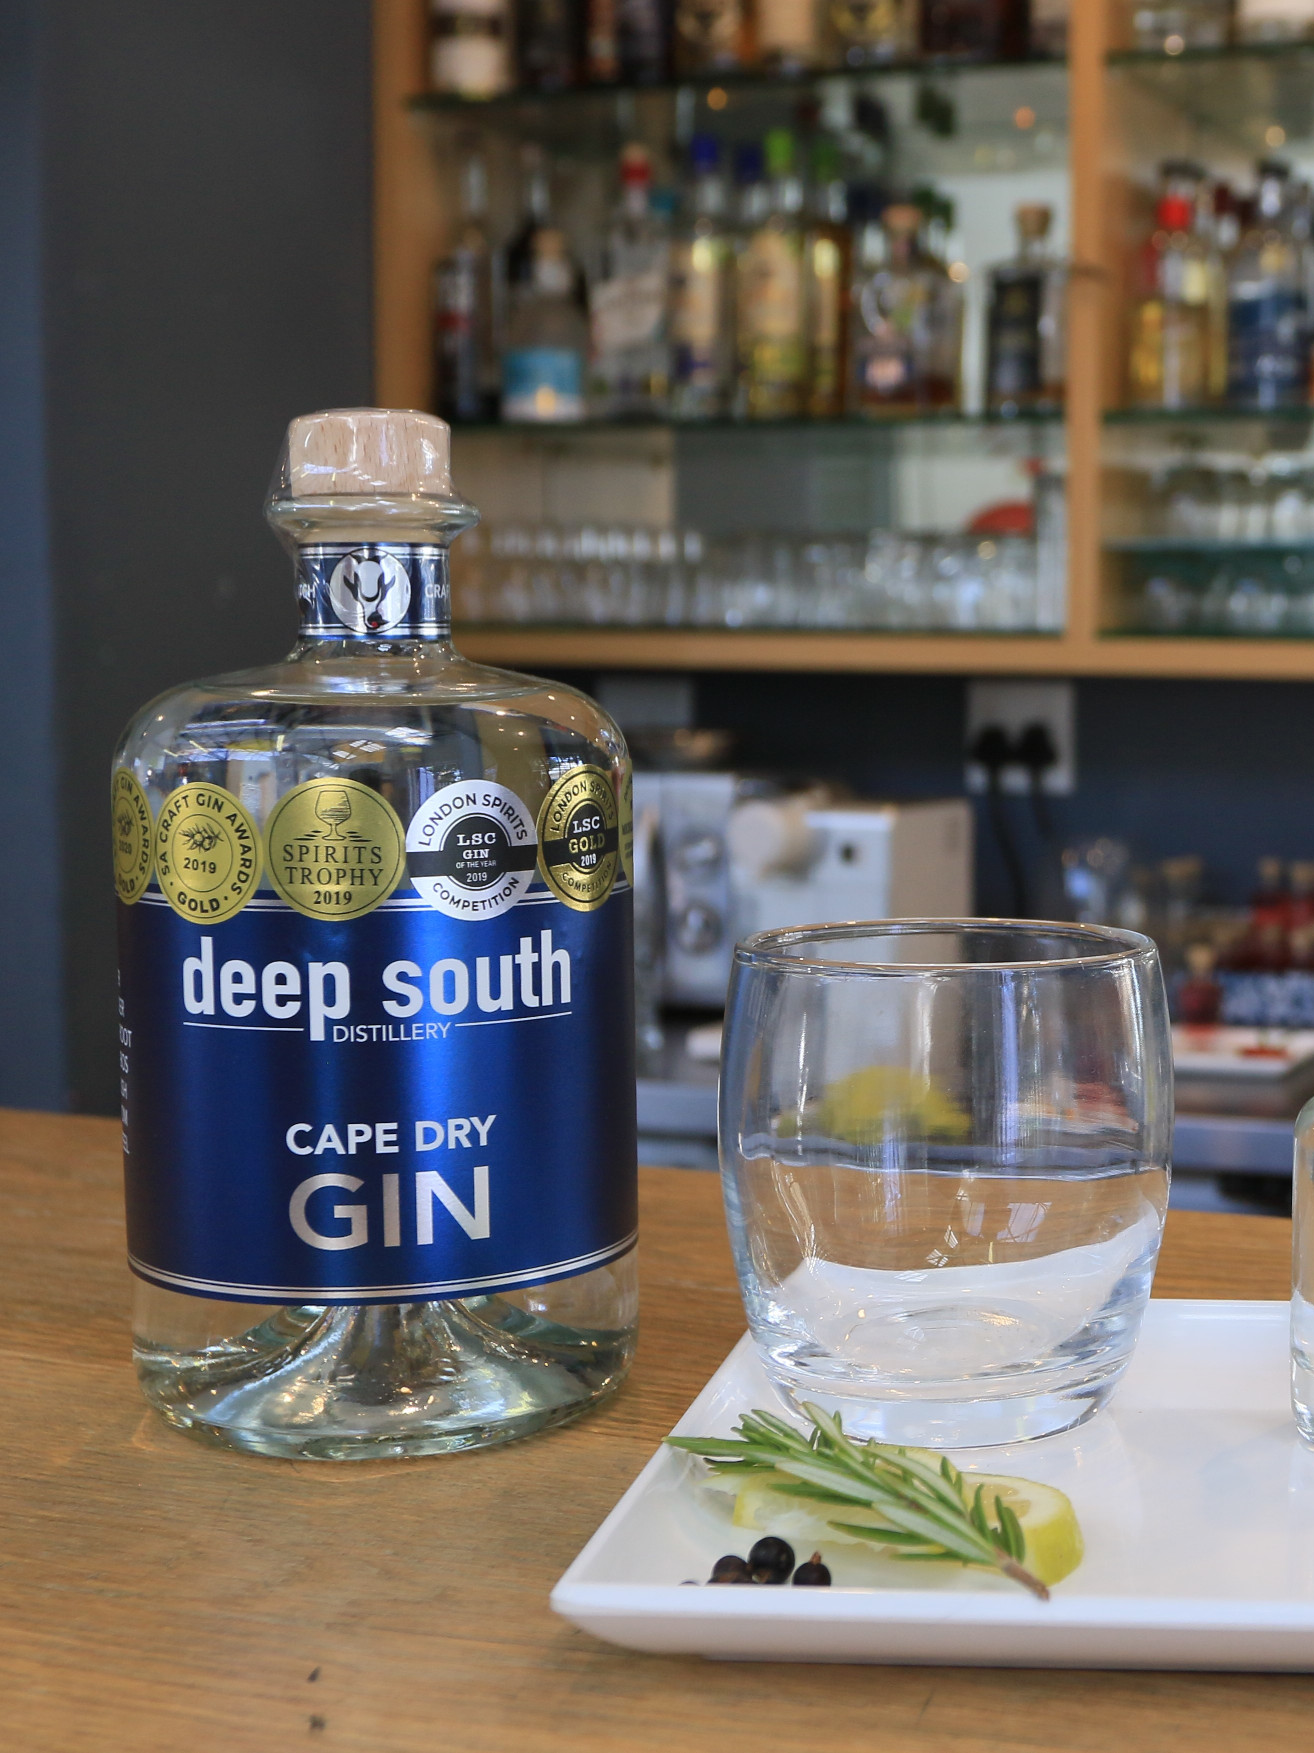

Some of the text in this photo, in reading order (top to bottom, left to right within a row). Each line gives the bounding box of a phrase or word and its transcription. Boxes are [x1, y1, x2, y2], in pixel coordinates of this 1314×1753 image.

[551, 780, 588, 833] LONDON
[589, 780, 614, 821] SPIRITS
[418, 792, 528, 846] LONDON SPIRITS
[572, 816, 600, 834] LSC
[133, 795, 150, 875] AWARDS
[160, 793, 252, 895] SA CRAFT GIN AWARDS
[456, 832, 497, 846] LSC
[568, 832, 606, 853] GOLD
[283, 844, 382, 864] SPIRITS
[455, 861, 466, 869] OF
[480, 860, 497, 868] YEAR
[462, 848, 490, 860] GIN
[581, 853, 597, 867] 2019
[183, 857, 217, 874] 2019
[285, 866, 384, 886] TROPHY
[466, 872, 488, 882] 2019
[562, 861, 612, 893] COMPETITION
[177, 891, 220, 914] GOLD
[313, 890, 352, 905] 2019
[432, 876, 520, 911] COMPETITION
[183, 929, 571, 1042] deep south
[333, 1021, 452, 1043] DISTILLERY
[286, 1114, 497, 1156] CAPE DRY
[289, 1166, 491, 1251] GIN
